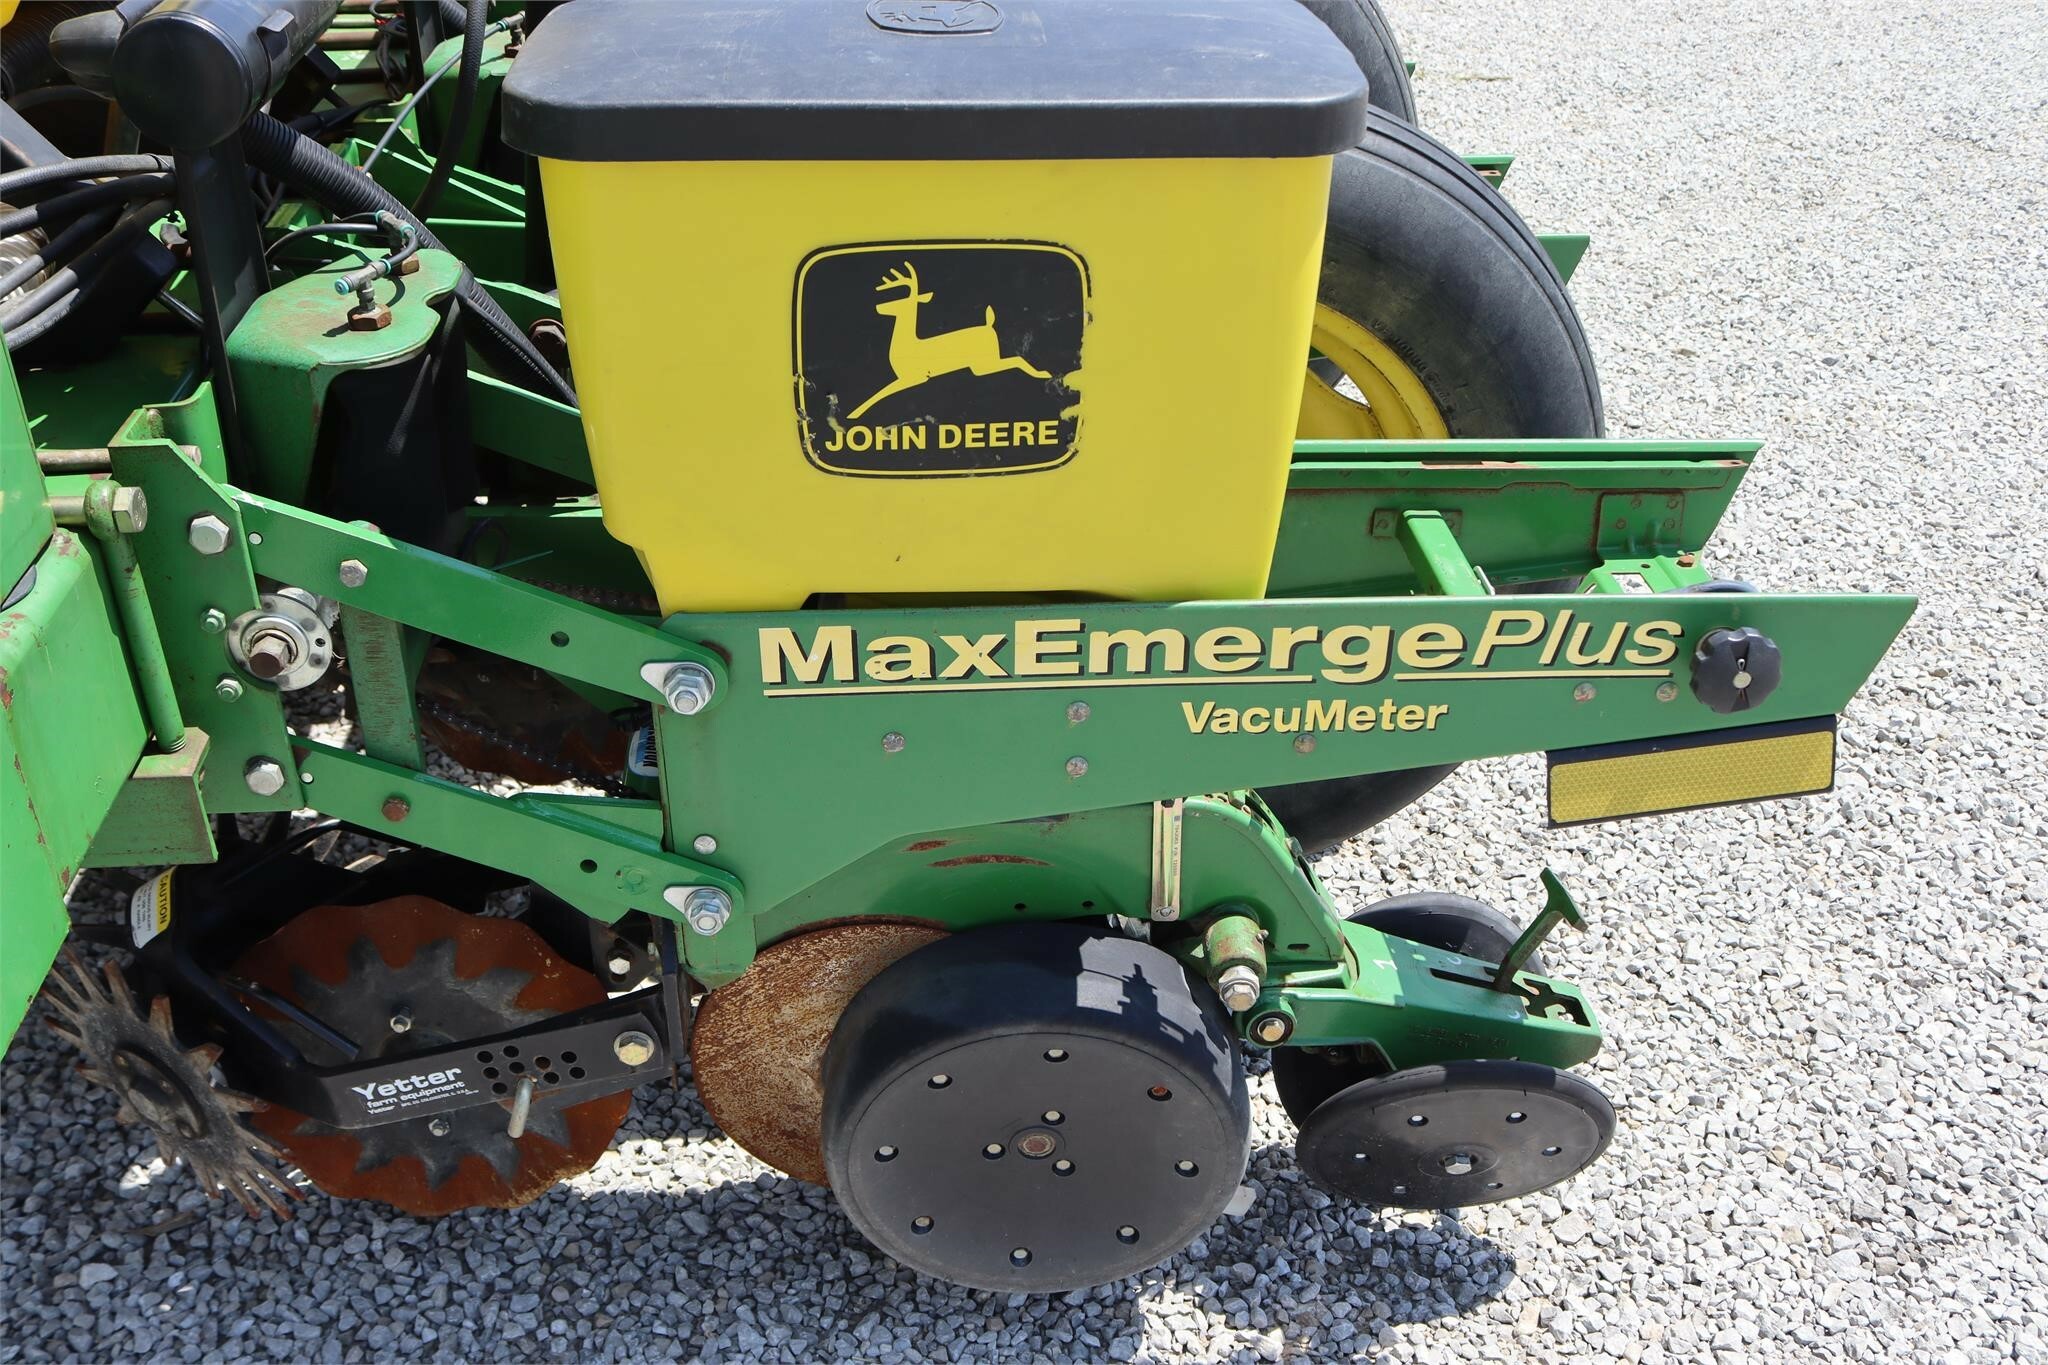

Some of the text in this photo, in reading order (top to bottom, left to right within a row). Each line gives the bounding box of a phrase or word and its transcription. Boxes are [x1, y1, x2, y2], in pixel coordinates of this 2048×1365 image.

[825, 420, 1059, 452] JOHN DEERE
[1182, 698, 1449, 735] VacuMeter
[160, 874, 169, 925] CAUTION
[352, 1067, 462, 1100] Yetter
[367, 1098, 398, 1109] farm
[400, 1081, 466, 1101] equipment
